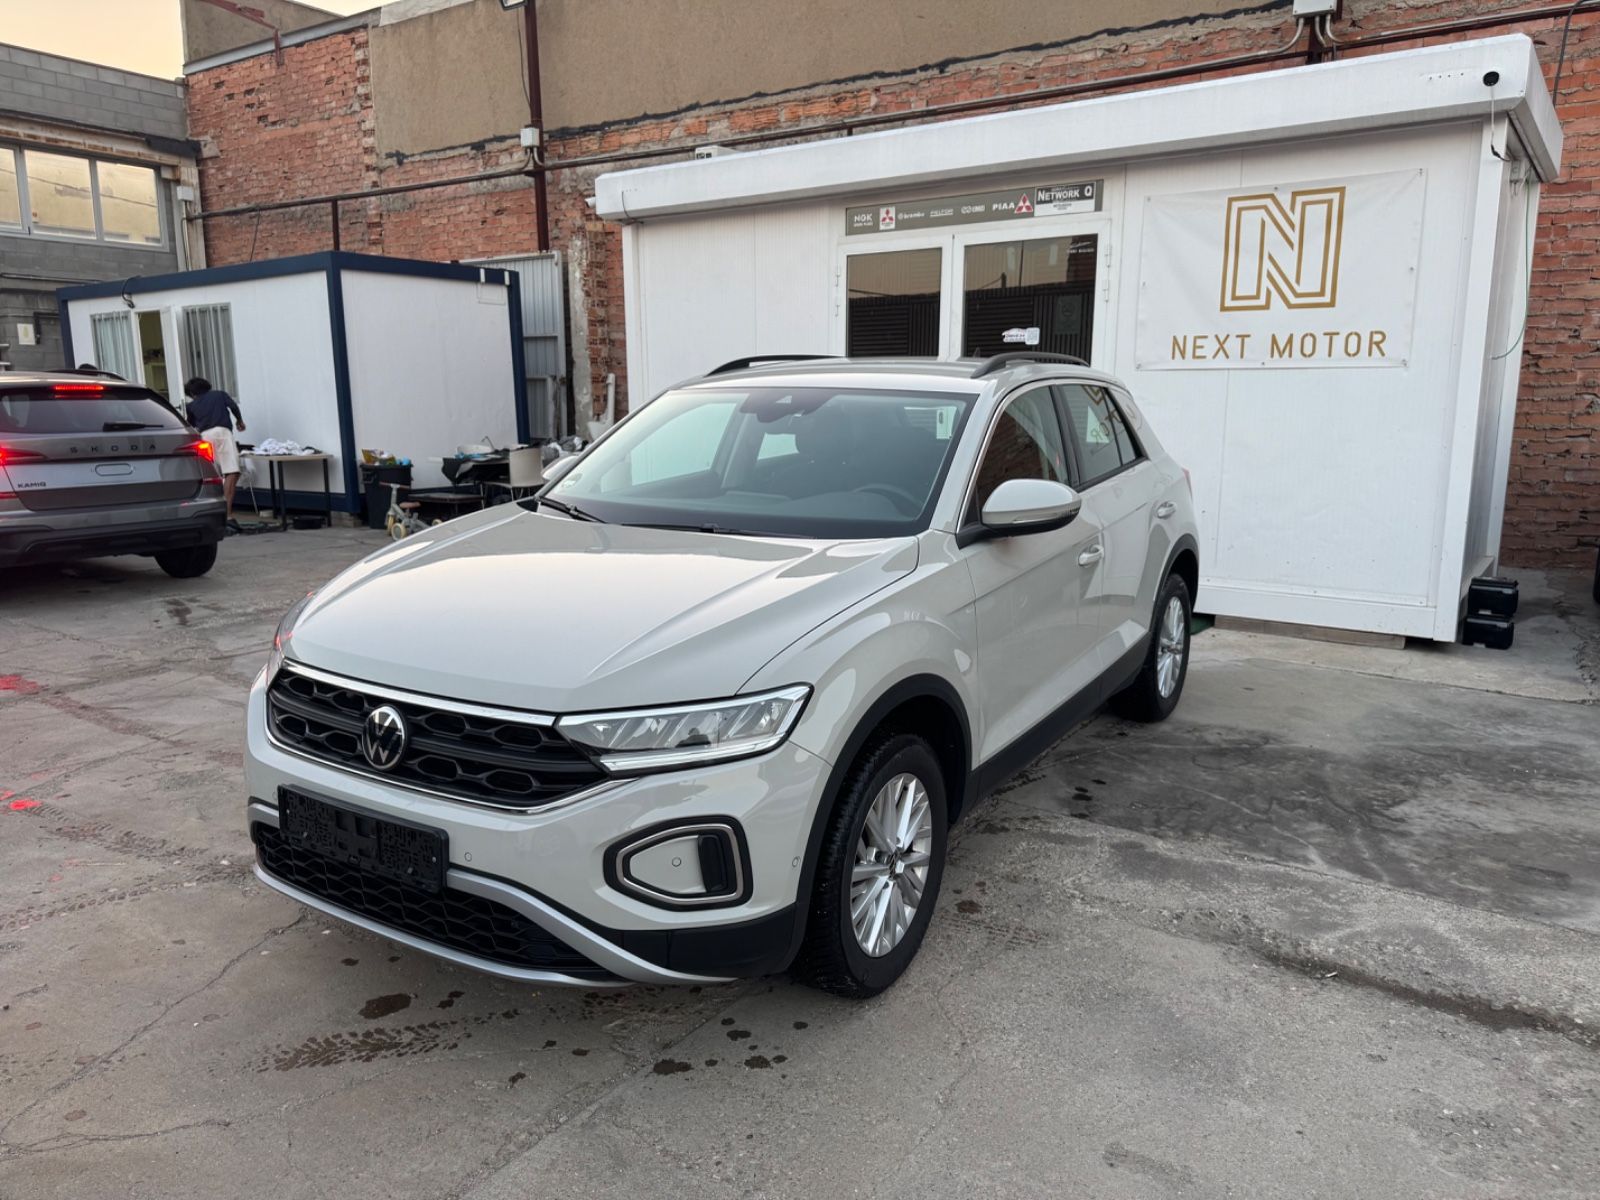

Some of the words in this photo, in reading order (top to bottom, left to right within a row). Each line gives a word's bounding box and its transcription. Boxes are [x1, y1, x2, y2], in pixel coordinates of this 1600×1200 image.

[1084, 185, 1093, 197] Q
[992, 202, 1015, 211] PIAA
[1171, 334, 1251, 360] NEXT
[1270, 330, 1387, 359] MOTOR
[17, 481, 47, 489] KAMIQ
